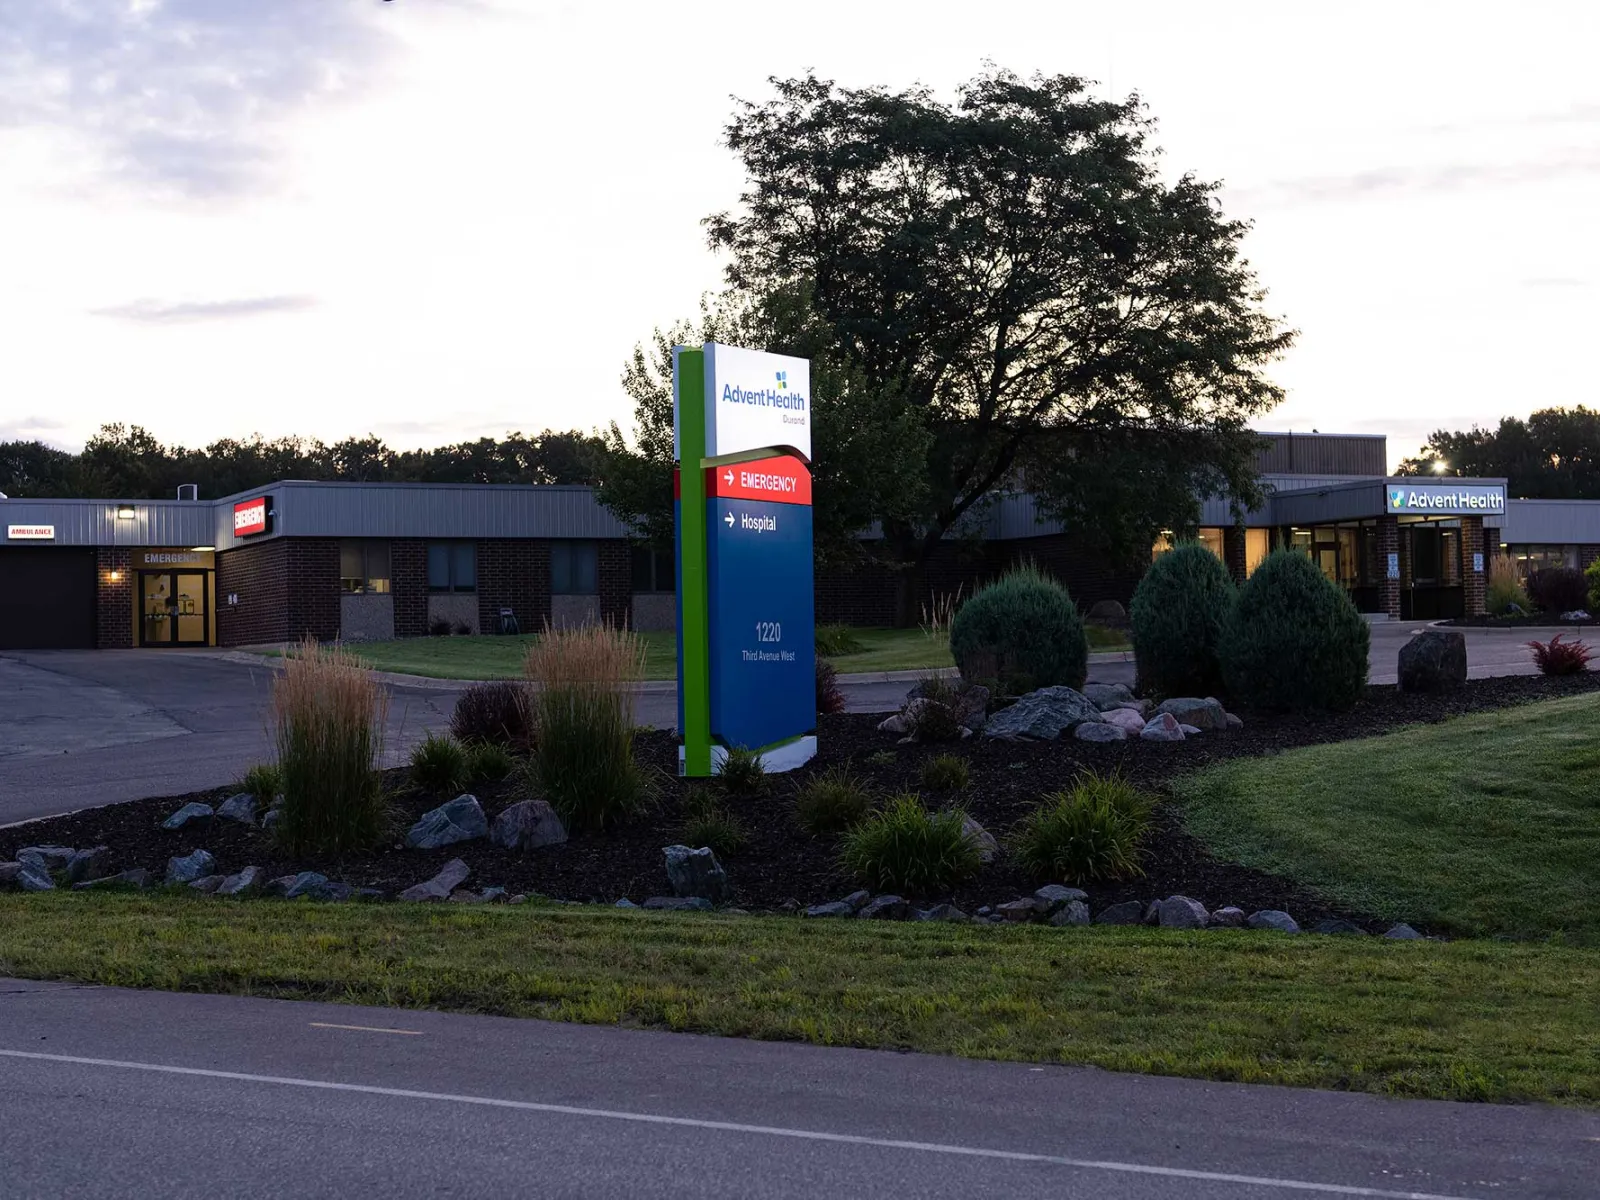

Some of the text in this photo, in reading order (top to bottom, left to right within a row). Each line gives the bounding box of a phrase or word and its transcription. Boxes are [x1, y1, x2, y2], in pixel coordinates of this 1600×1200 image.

[722, 383, 805, 411] AdventHealth
[783, 414, 805, 425] Durand
[741, 472, 797, 492] EMERGENCY
[1408, 491, 1504, 509] AdventHealth
[741, 513, 776, 533] Hospital
[756, 621, 781, 642] 1220
[742, 649, 796, 661] Third Avenue West
